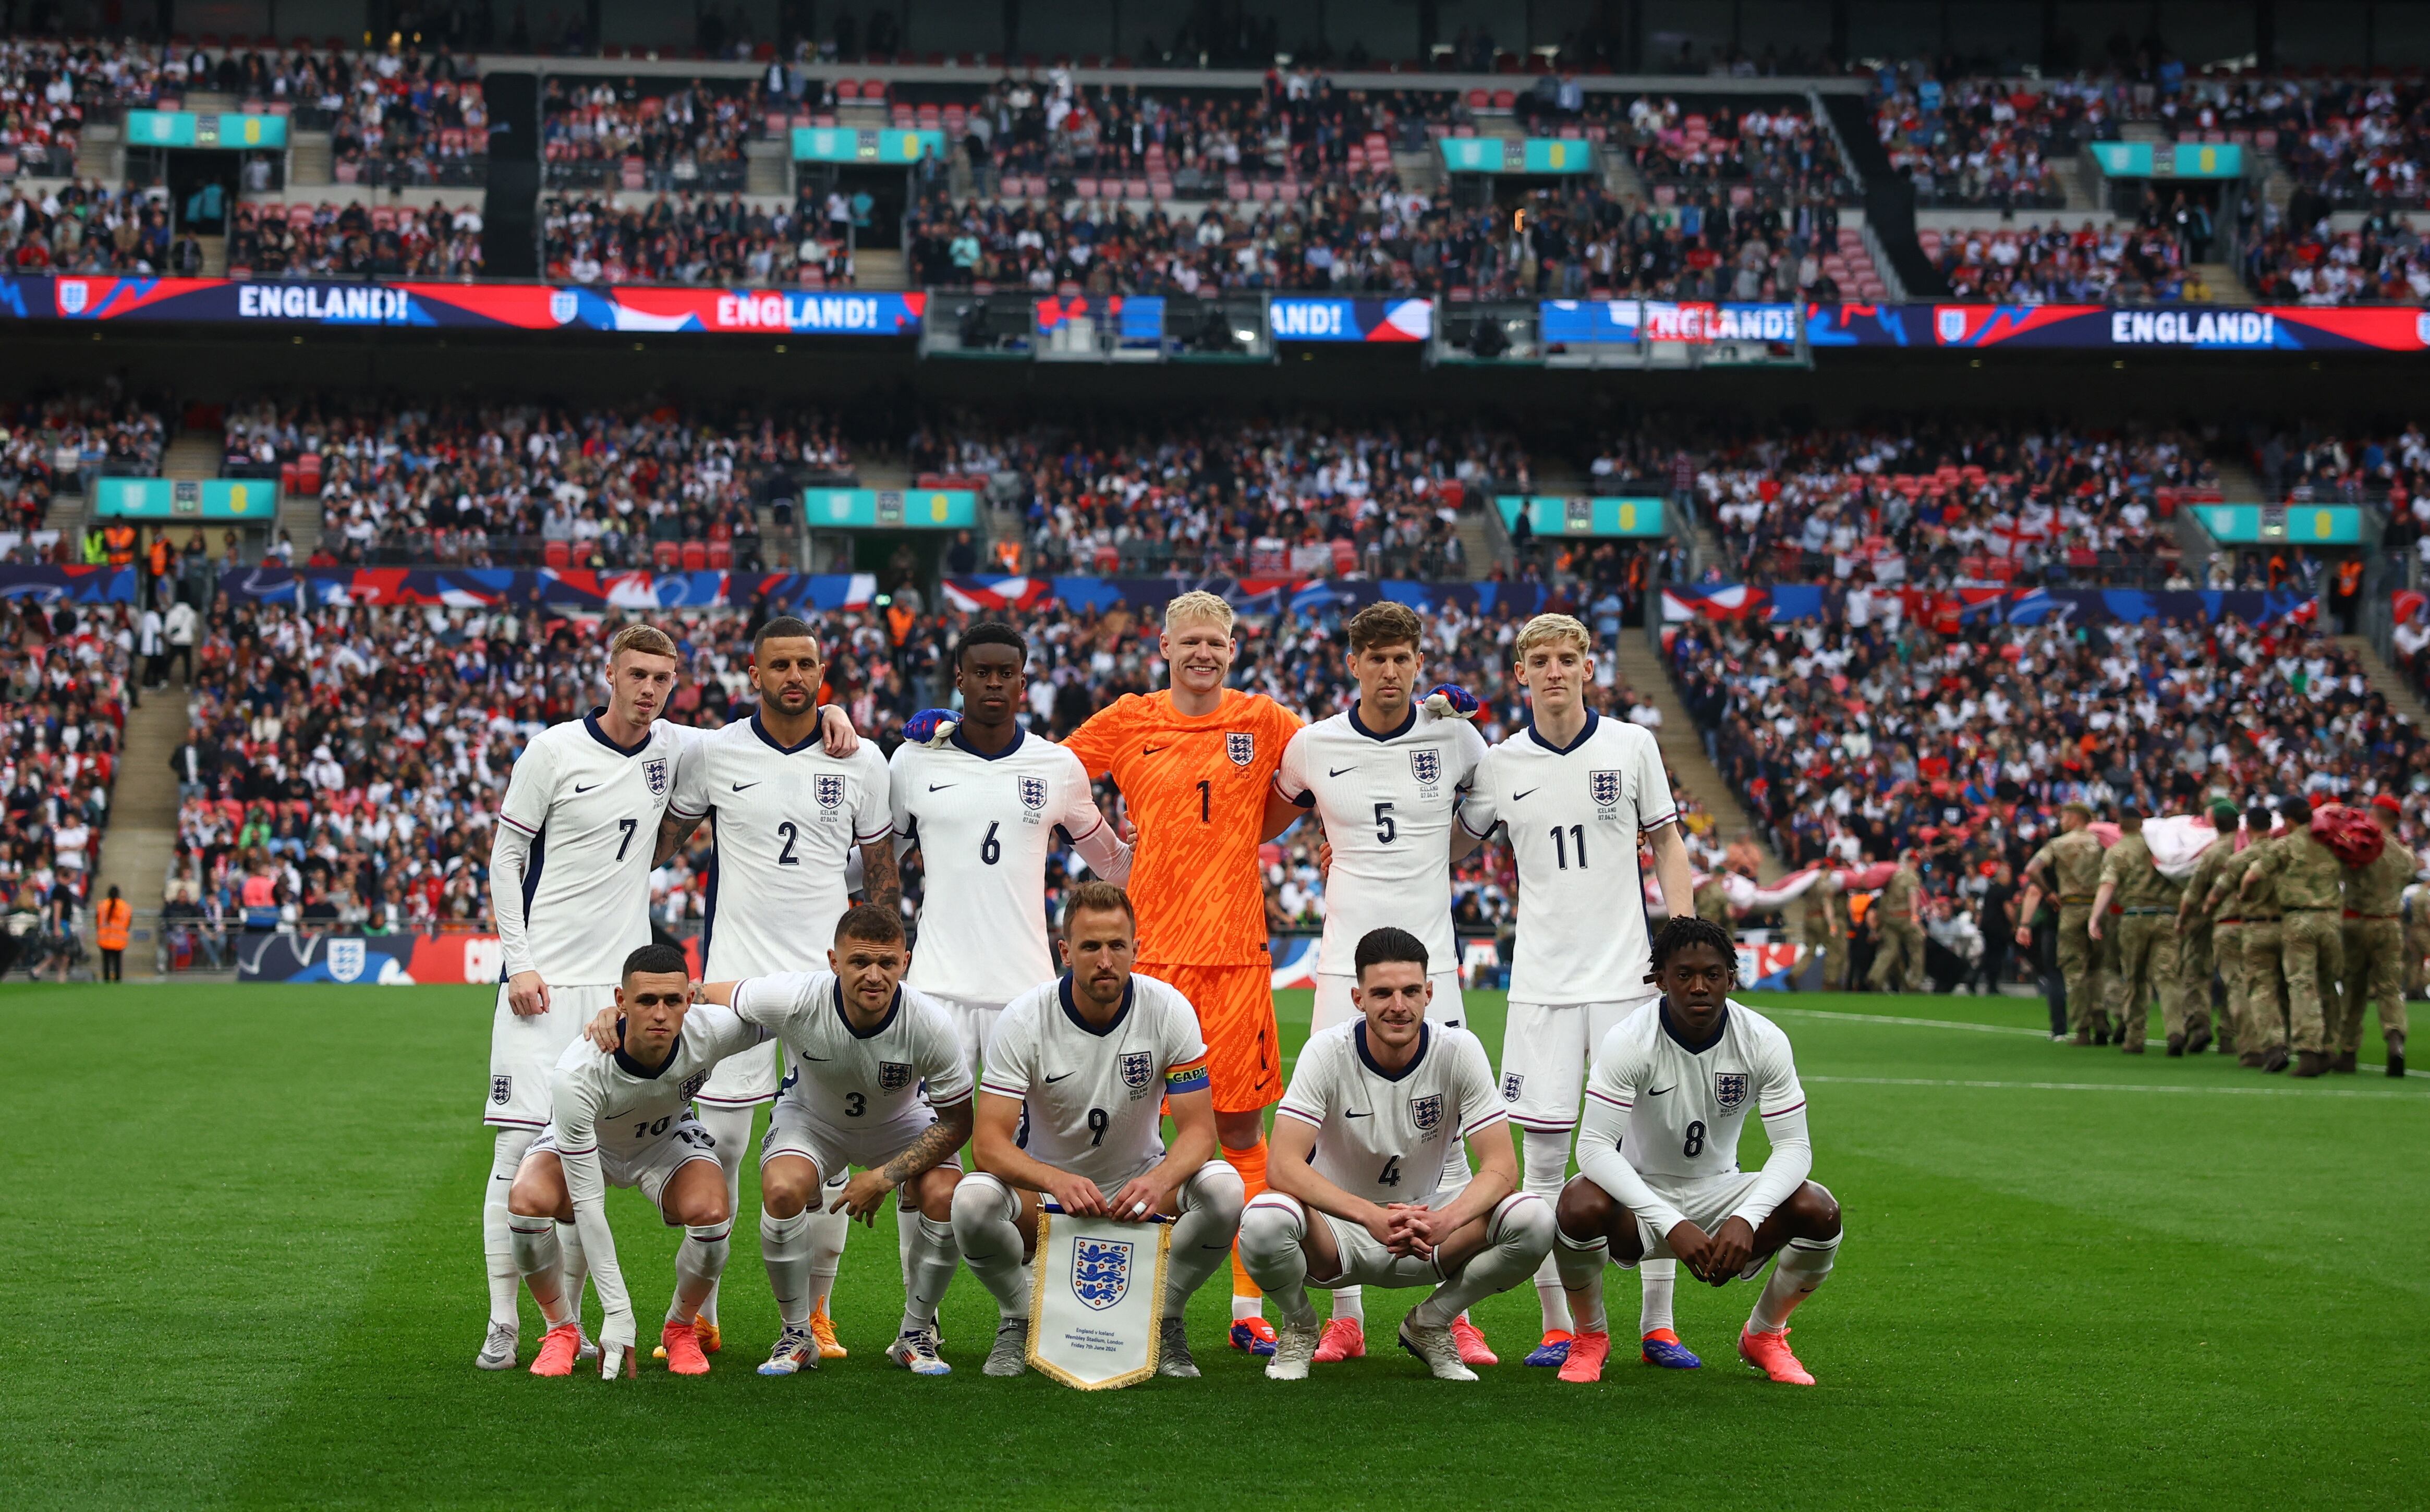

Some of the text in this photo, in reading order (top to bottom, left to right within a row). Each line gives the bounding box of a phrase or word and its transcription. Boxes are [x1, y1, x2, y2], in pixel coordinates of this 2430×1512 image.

[239, 285, 408, 320] ENGLAND!
[717, 295, 877, 329] ENGLAND!
[1646, 309, 1795, 339] NGLAND!
[2112, 311, 2274, 344] ENGLAND!
[1024, 810, 1041, 819] ICELAND
[1196, 780, 1210, 824] 1
[1374, 802, 1397, 845] 5
[616, 819, 638, 862] 7
[778, 821, 799, 865] 2
[980, 821, 1001, 865] 6
[1550, 824, 1587, 870] 11
[845, 1092, 866, 1117] 3
[1129, 1087, 1148, 1096] ICELAND
[1131, 1092, 1147, 1101] 07.06.24
[634, 1115, 673, 1138] 10
[1088, 1108, 1109, 1147] 9
[1421, 1128, 1438, 1139] ICELAND
[1421, 1135, 1437, 1143] 07.06.24
[1683, 1120, 1706, 1158] 8
[1378, 1155, 1401, 1187] 4
